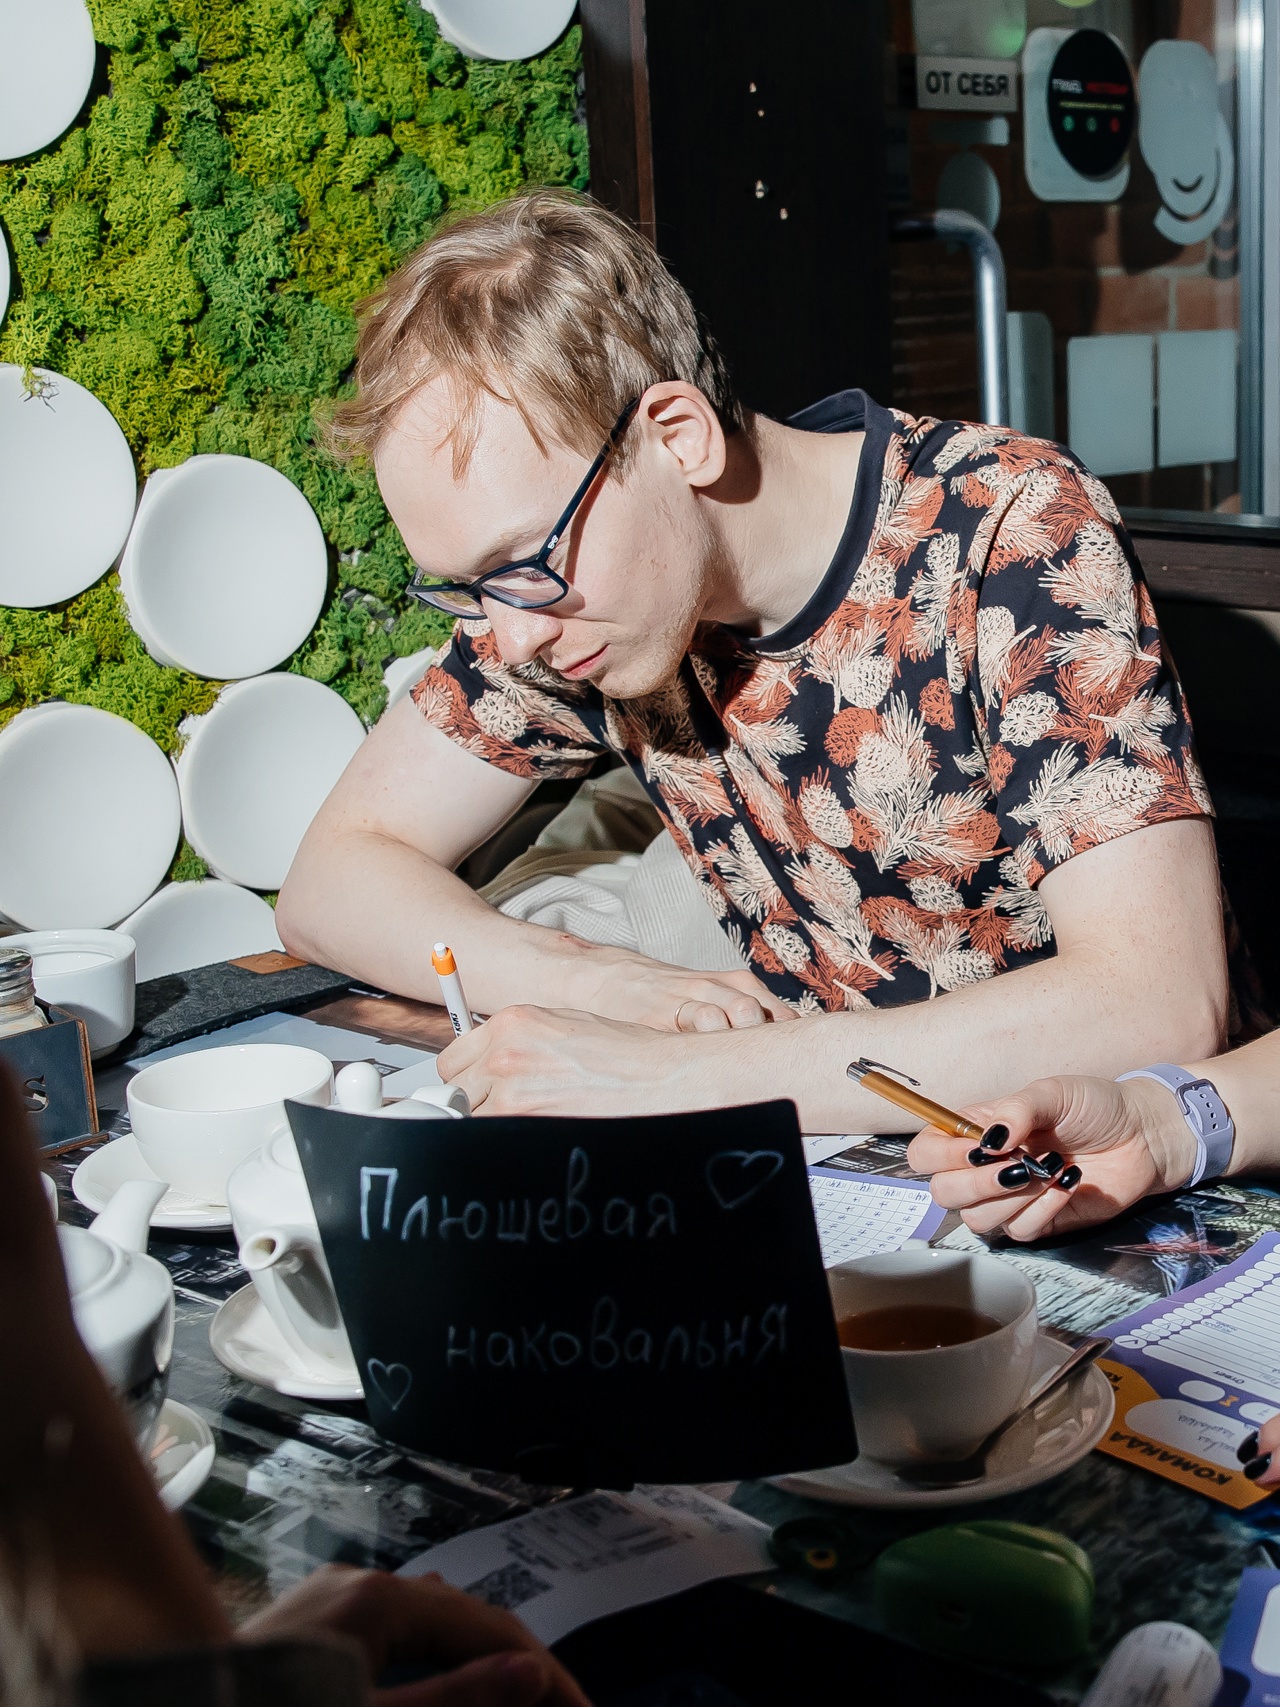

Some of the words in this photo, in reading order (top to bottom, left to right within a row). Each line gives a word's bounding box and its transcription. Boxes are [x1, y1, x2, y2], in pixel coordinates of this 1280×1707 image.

[925, 71, 951, 95] ОТ
[956, 72, 1009, 97] СЕБЯ
[360, 1147, 677, 1243] Плюшевая
[447, 1297, 788, 1371] наковальня
[1109, 1430, 1233, 1486] КОМАНДА
